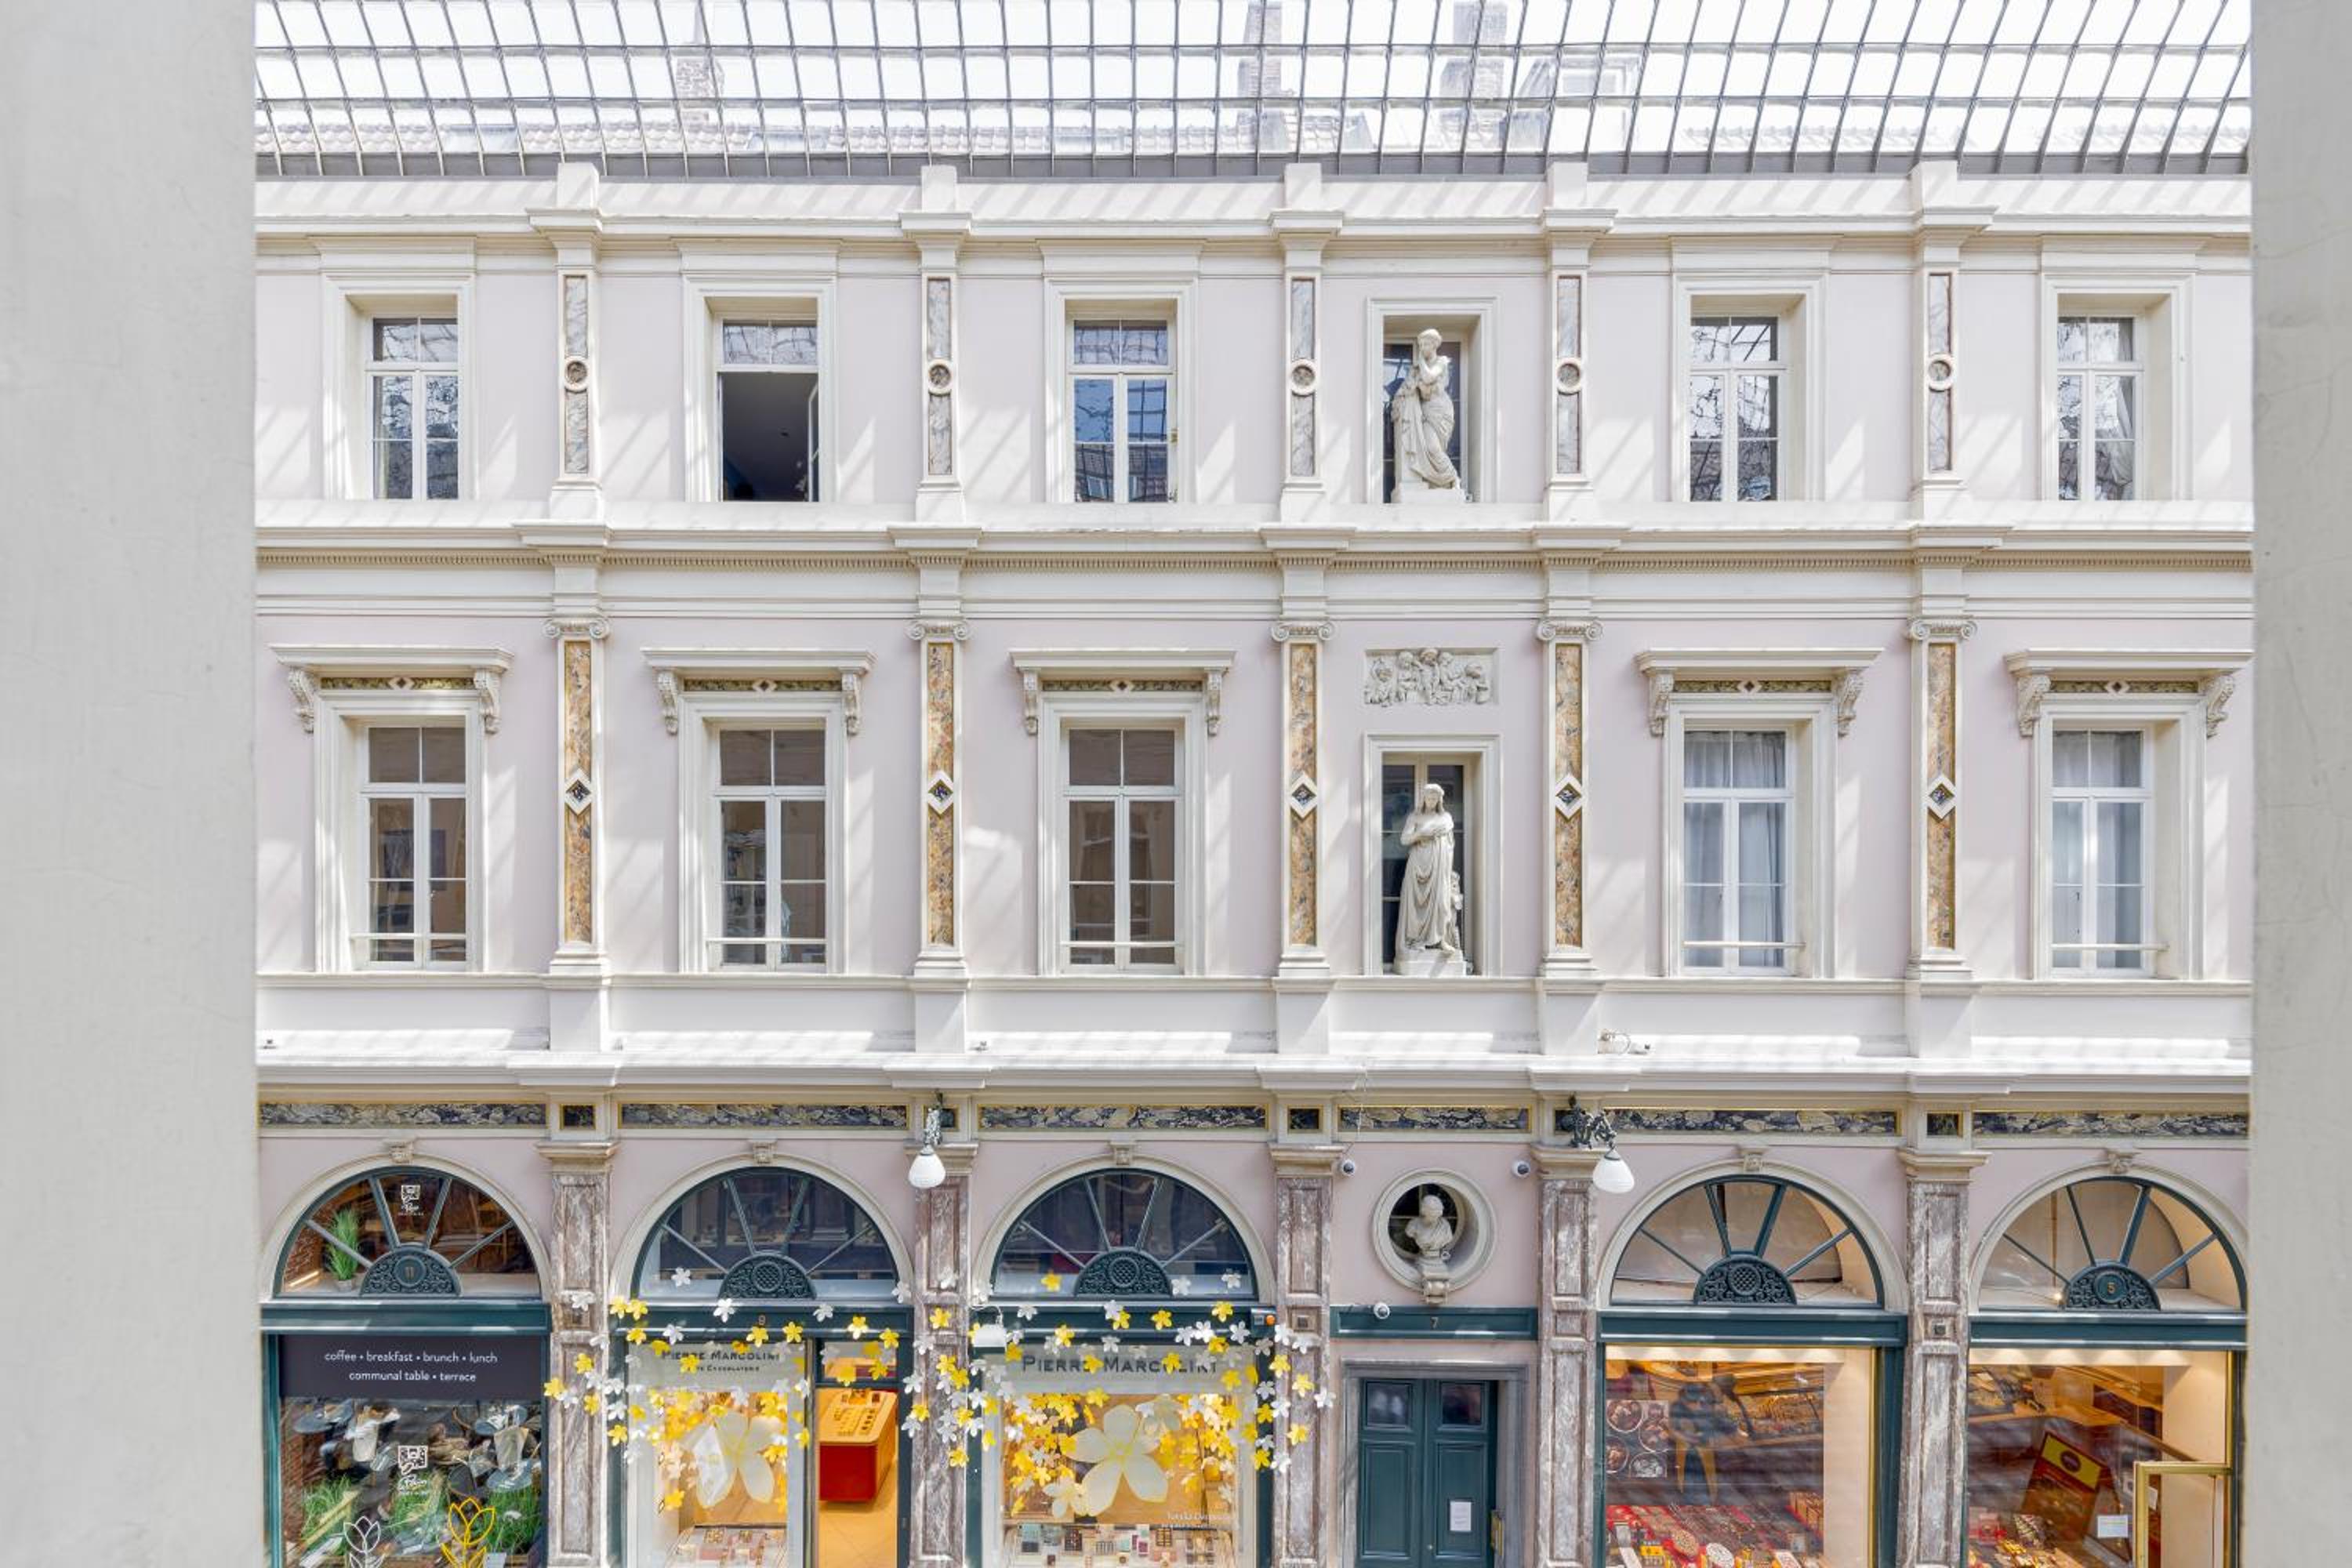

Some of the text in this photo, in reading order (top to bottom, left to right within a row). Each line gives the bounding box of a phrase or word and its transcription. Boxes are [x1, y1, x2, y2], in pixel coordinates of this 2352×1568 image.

[1432, 1316, 1439, 1330] 7
[325, 1349, 498, 1363] coffee breakfast brunch lunch
[349, 1370, 476, 1381] communal table terrace
